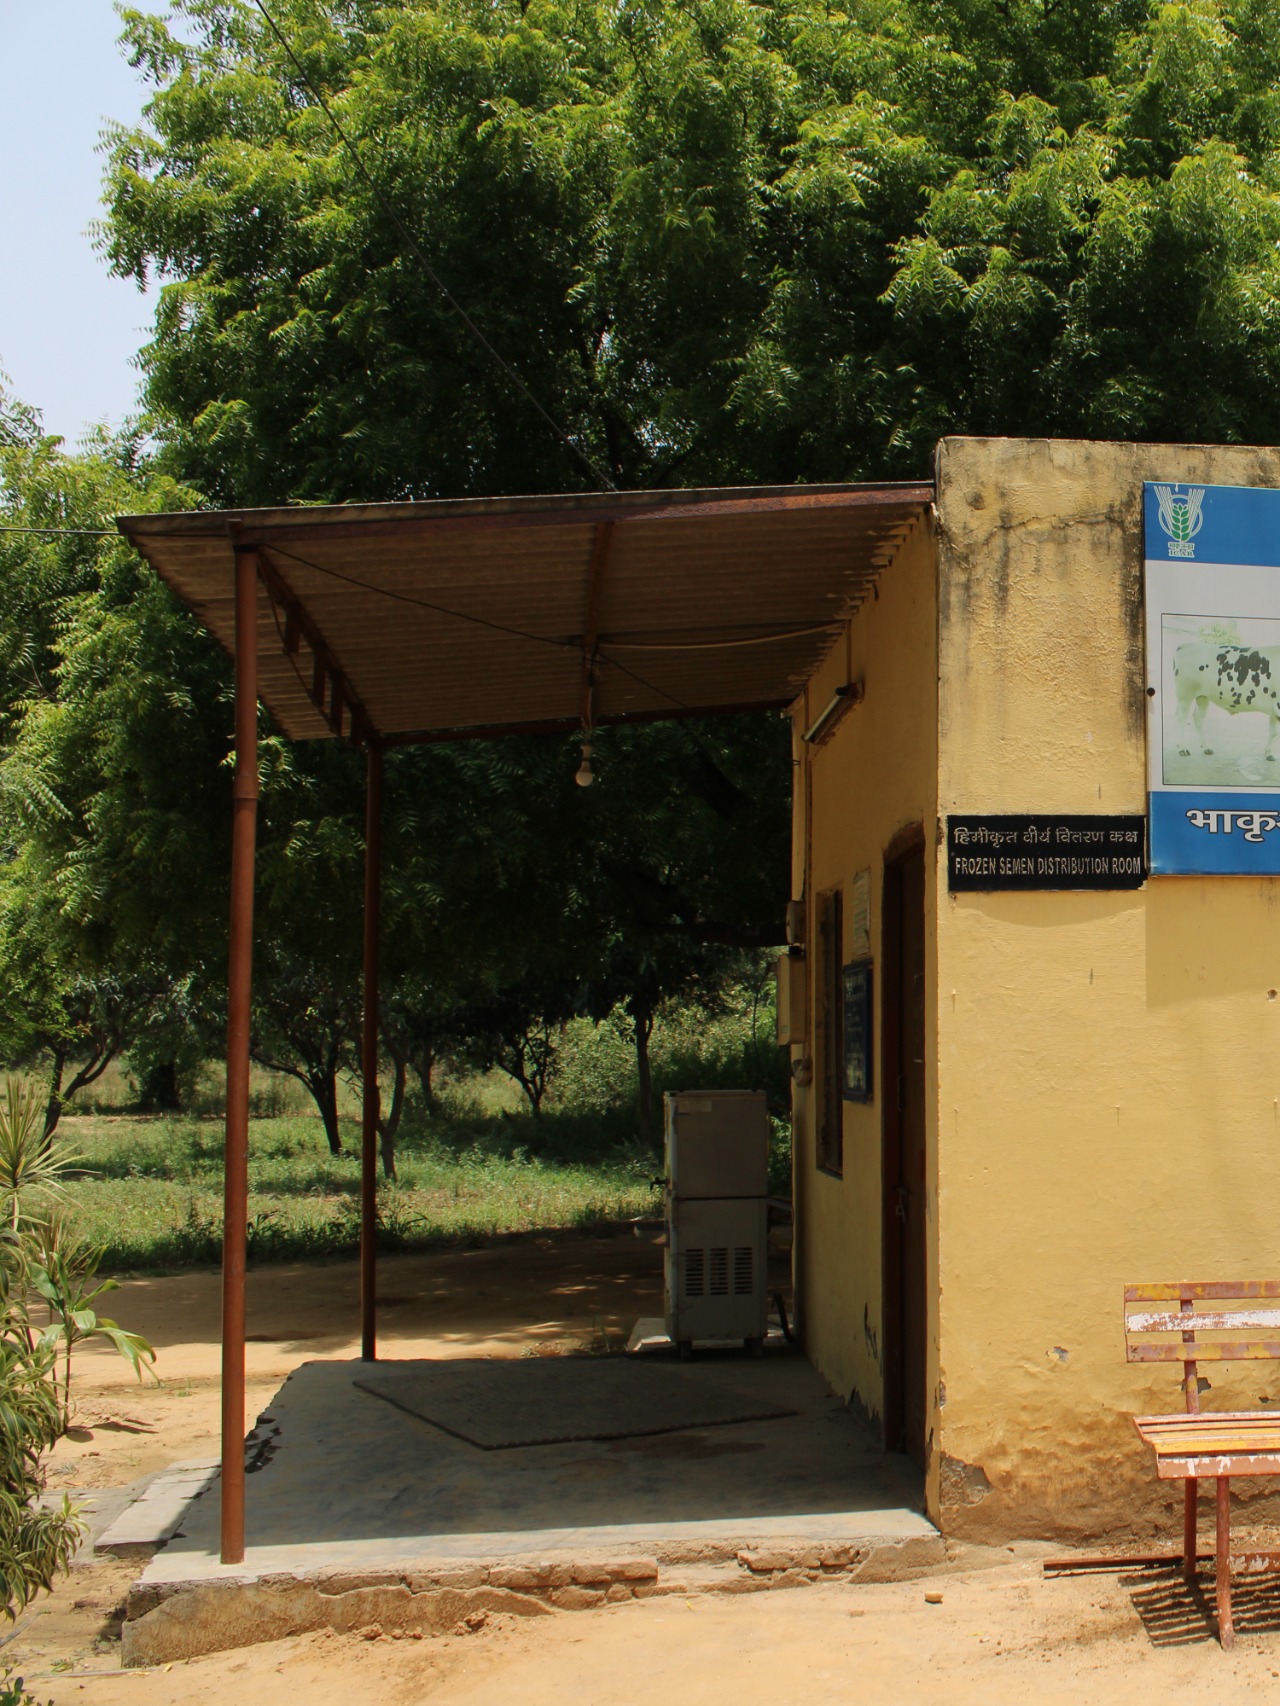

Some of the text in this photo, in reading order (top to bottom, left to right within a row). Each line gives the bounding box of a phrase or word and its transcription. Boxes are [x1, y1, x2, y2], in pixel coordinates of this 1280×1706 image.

[953, 825, 1139, 848] हिमीकृत वीर्य वितरण कक्ष
[955, 857, 1141, 875] FROZEN SEMEN DISTRIBUTION ROOM
